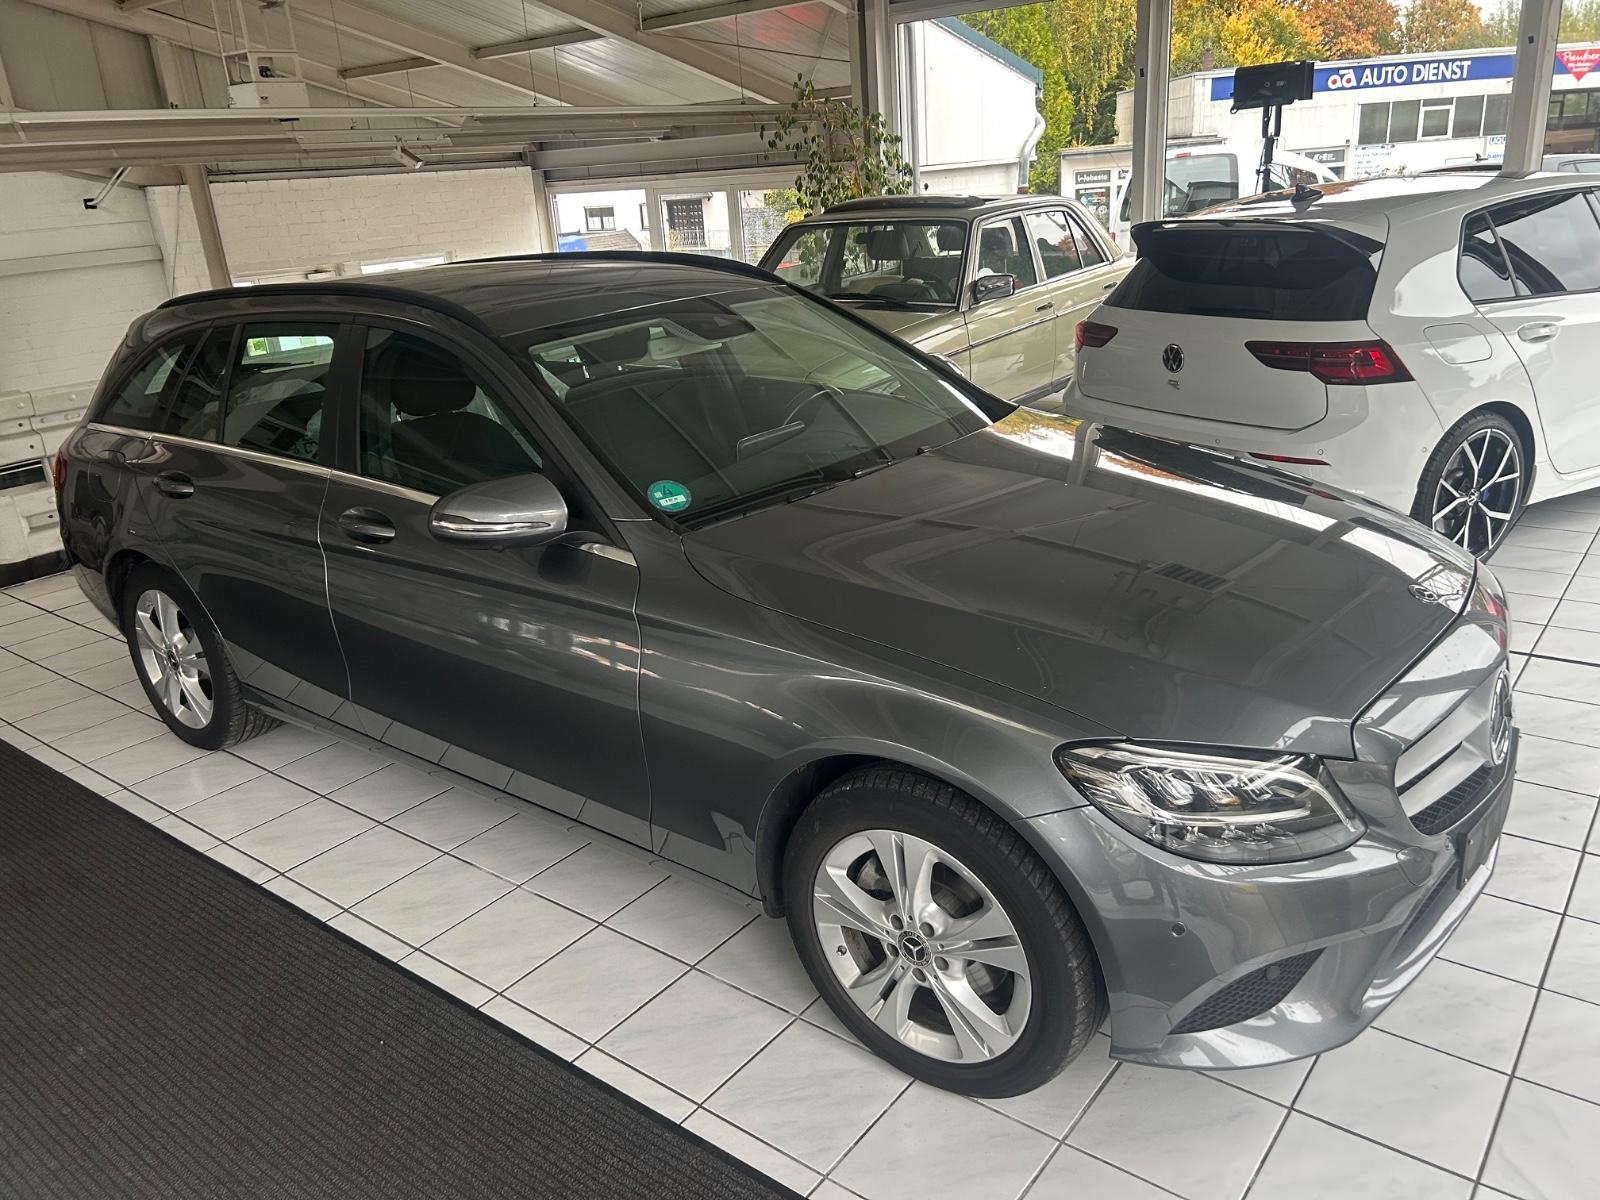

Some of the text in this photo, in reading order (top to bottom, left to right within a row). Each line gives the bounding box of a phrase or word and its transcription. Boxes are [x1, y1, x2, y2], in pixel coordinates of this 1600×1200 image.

[1360, 65, 1408, 86] AUTO
[1412, 60, 1472, 82] DIENST
[1077, 173, 1108, 183] Webasto
